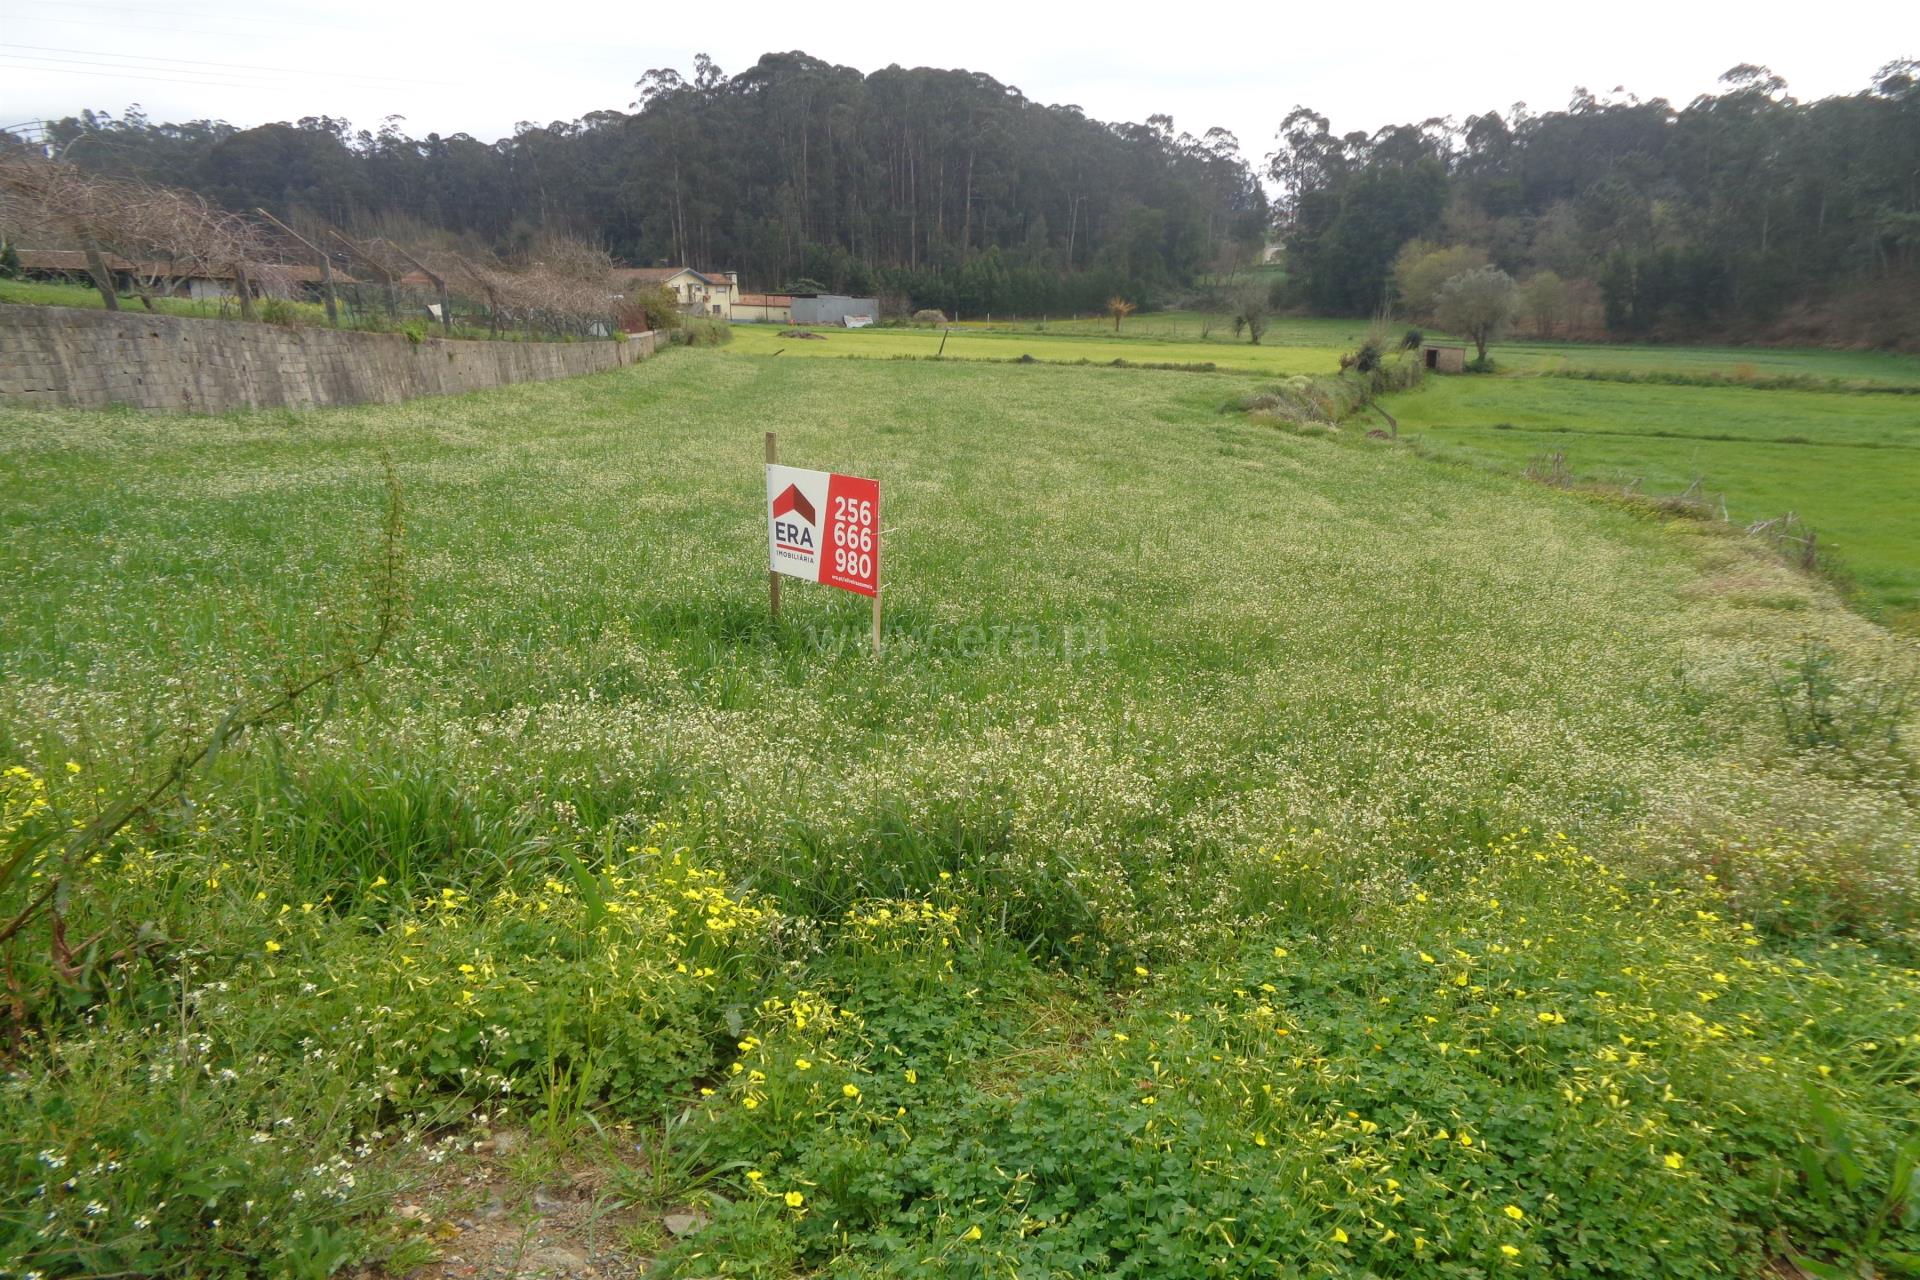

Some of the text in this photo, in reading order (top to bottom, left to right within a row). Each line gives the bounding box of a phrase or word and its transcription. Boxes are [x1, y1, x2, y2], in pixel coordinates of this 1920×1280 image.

[834, 496, 872, 525] 256
[776, 521, 814, 548] ERA
[834, 522, 872, 552] 666
[776, 549, 814, 564] IMOBILIÁRIA
[835, 548, 871, 579] 980
